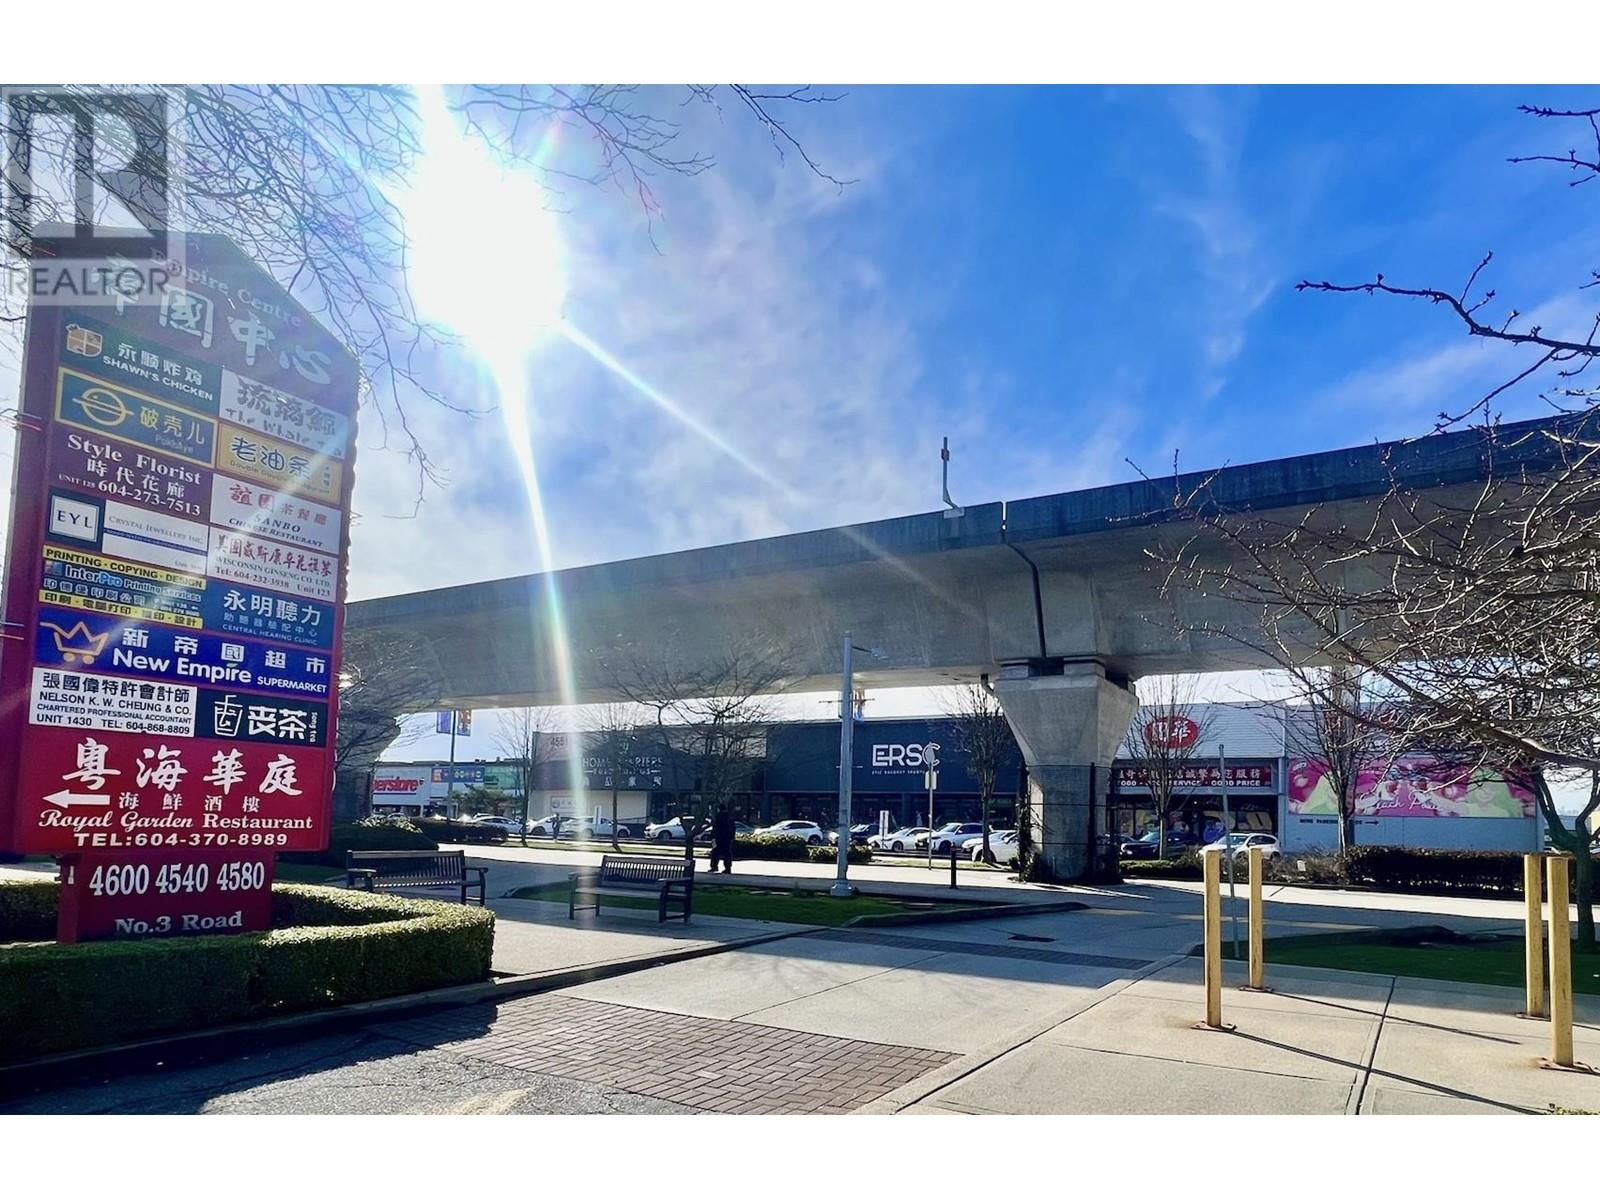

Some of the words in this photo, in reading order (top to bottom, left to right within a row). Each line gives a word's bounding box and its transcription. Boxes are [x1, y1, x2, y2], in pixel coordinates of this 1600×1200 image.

[103, 355, 160, 382] SHAWN'S
[162, 378, 213, 401] CHICKEN
[67, 434, 123, 462] Style
[136, 453, 201, 485] Florist
[86, 458, 185, 499] 時代花廊
[58, 472, 80, 485] UNIT
[98, 479, 201, 518] 604-273-7513
[45, 548, 102, 567] PRINTING
[110, 562, 159, 580] COPYING
[65, 564, 123, 588] InterPro
[223, 589, 321, 626] 永明聽力
[222, 623, 257, 636] CENTRAL
[259, 630, 292, 641] HEARING
[122, 627, 326, 674] 新帝國超市
[112, 647, 171, 673] New
[176, 656, 252, 684] Empire
[256, 675, 328, 693] SUPERMARKET
[42, 672, 190, 703] 張國偉特許會計師
[36, 703, 86, 715] CHARTERED
[87, 708, 144, 720] PROFESSIONAL
[145, 713, 193, 725] ACCOUNTANT
[39, 691, 86, 705] NELSON
[88, 697, 100, 706] K.
[102, 699, 115, 708] W.
[118, 699, 163, 712] CHEUNG
[165, 704, 172, 712] &
[174, 705, 193, 716] CO.
[36, 713, 64, 724] UNIT
[67, 716, 93, 727] 1430
[101, 718, 124, 729] TEL:
[126, 722, 191, 734] 604-868-8809
[872, 742, 941, 768] ERSC
[119, 791, 261, 812] 海鮮酒樓
[38, 810, 114, 832] Royal
[120, 811, 194, 832] Garden
[202, 813, 313, 830] Restaurant
[73, 832, 289, 847] TEL:604-370-8989
[89, 863, 150, 897] 4600
[154, 862, 209, 894] 4540
[216, 860, 266, 892] 4580
[114, 917, 172, 935] No.3
[181, 910, 243, 931] Road
